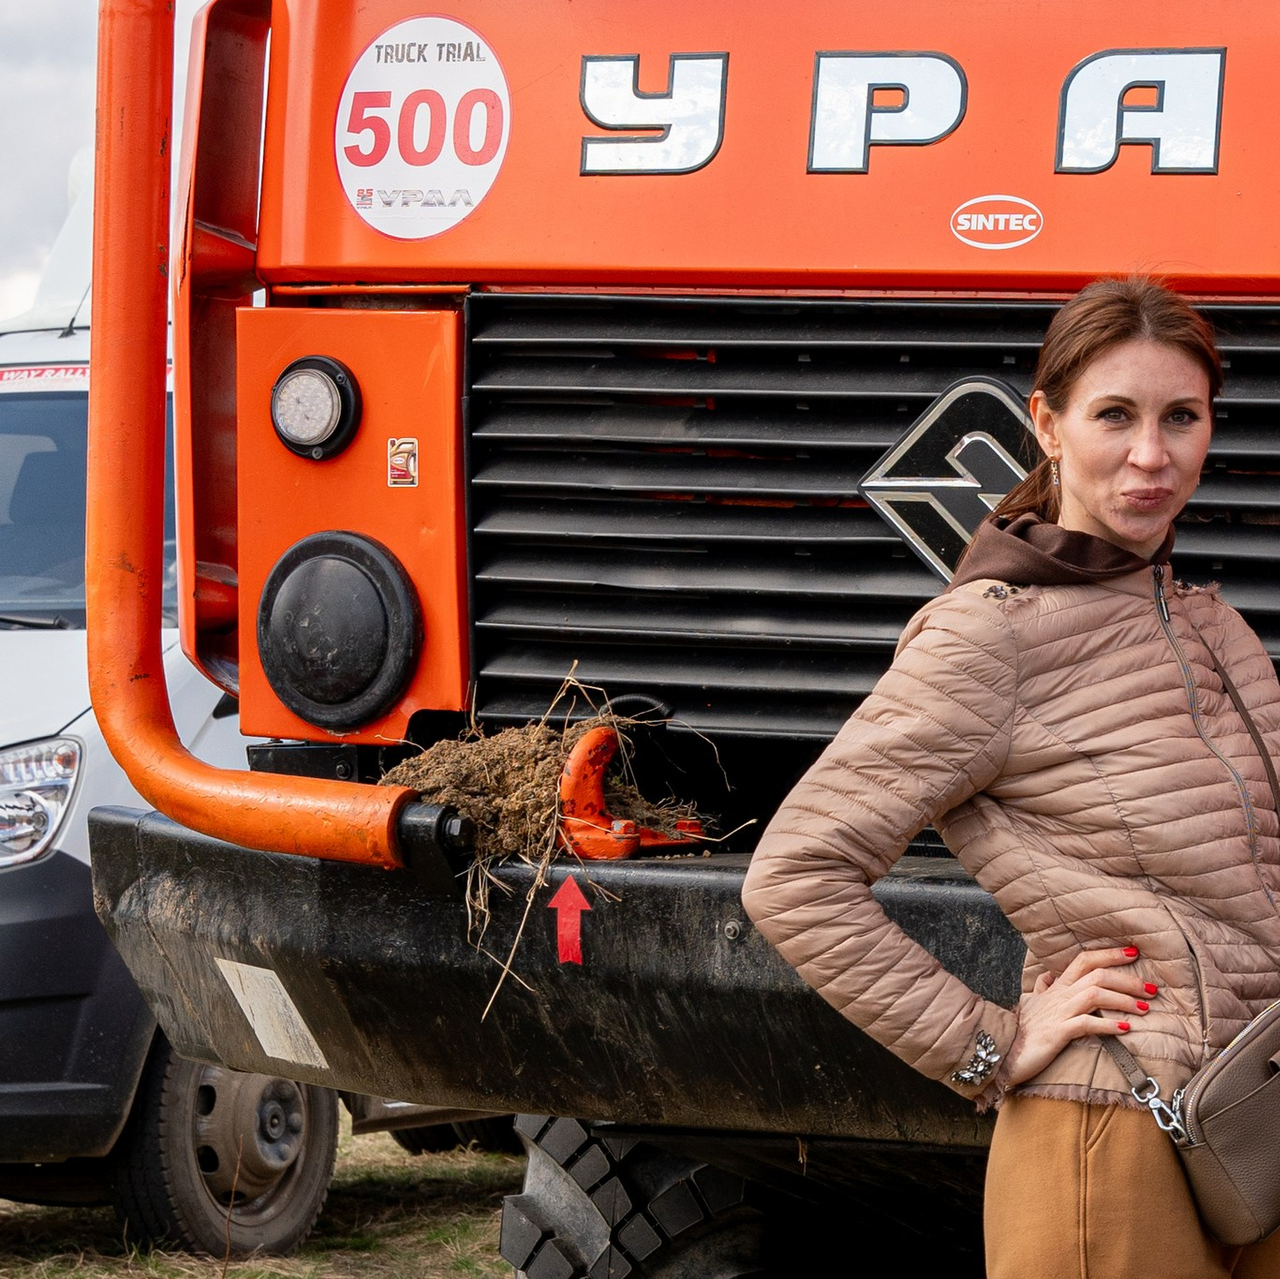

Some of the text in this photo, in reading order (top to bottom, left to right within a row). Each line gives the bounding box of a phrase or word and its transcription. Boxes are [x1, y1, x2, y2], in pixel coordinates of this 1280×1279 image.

[375, 41, 486, 63] TRUCK TRIAL
[343, 88, 504, 167] 500
[376, 189, 474, 208] УРАЛ
[957, 213, 1037, 231] SINTEC
[2, 370, 41, 380] WAY
